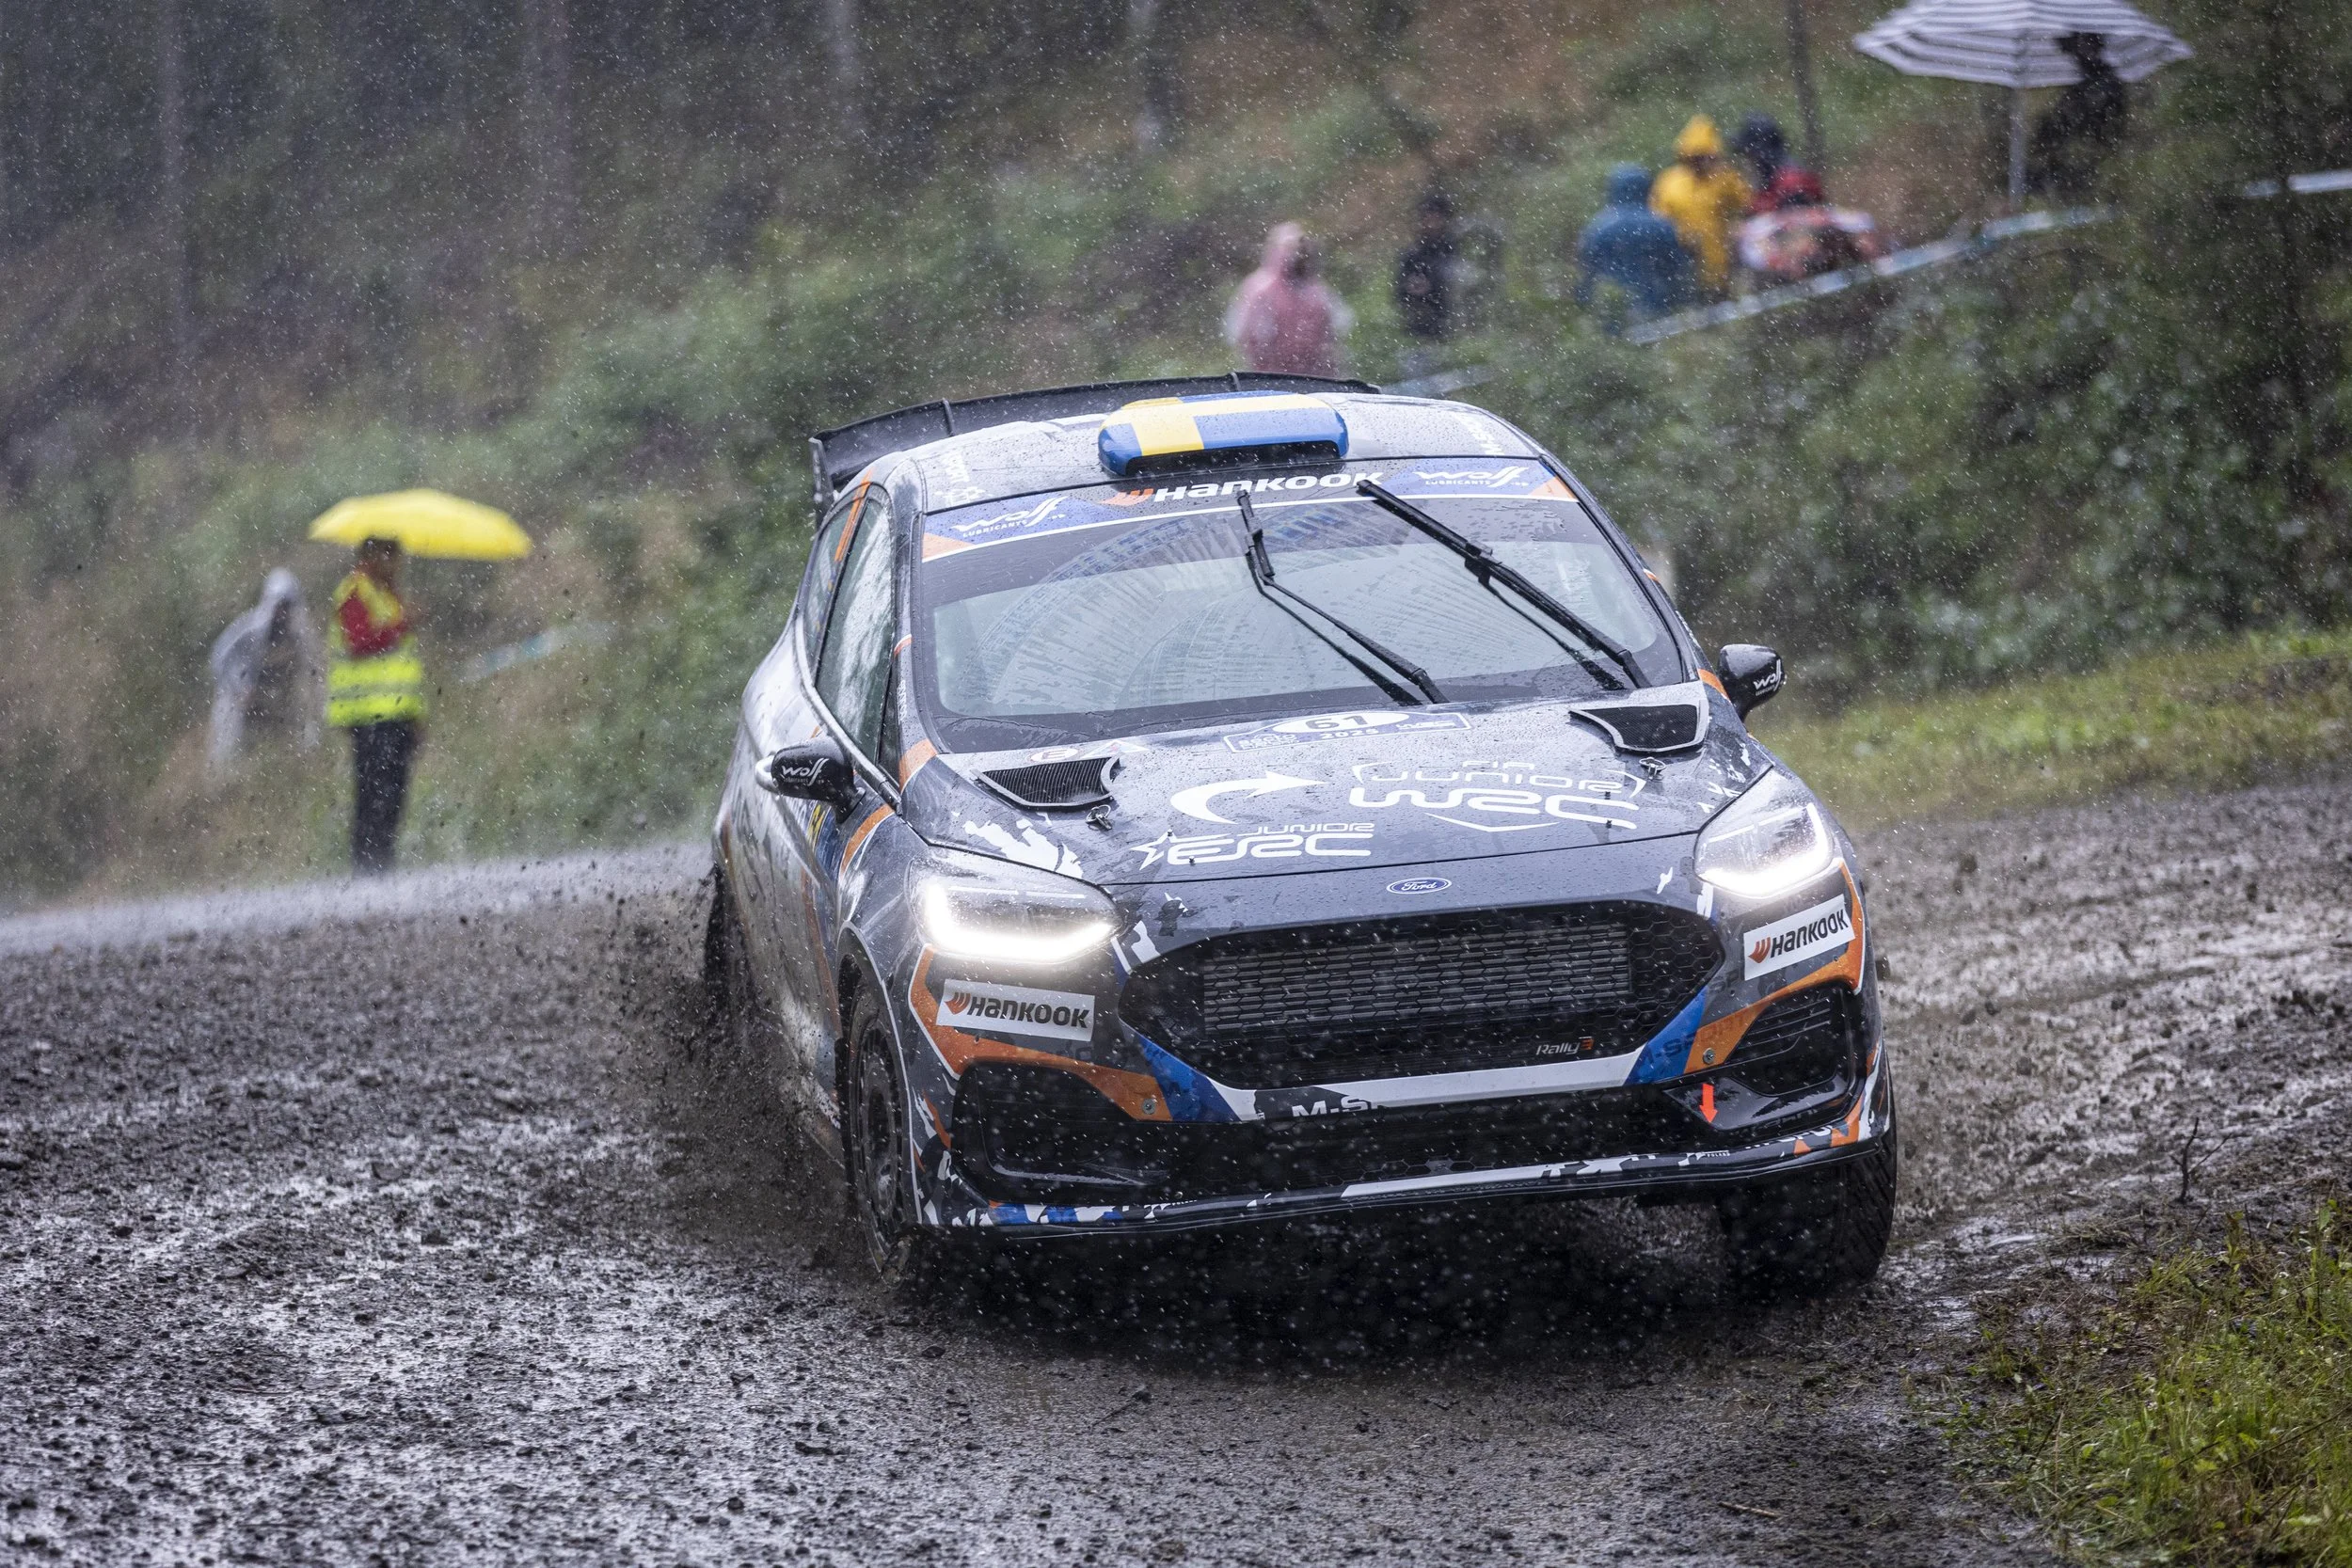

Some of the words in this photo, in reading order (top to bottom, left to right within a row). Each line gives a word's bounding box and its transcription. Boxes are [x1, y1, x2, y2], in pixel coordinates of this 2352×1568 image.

[962, 519, 1028, 537] LUBRICANTS
[1305, 715, 1370, 729] 61
[1320, 729, 1379, 739] 2025
[1372, 770, 1622, 793] JUNIOR
[1348, 787, 1640, 830] WRC
[1237, 823, 1375, 836] JUNIOR
[1167, 833, 1374, 865] ERC
[1402, 880, 1437, 891] Ford
[1770, 909, 1850, 958] HANKOOK
[967, 995, 1090, 1029] HANKOOK
